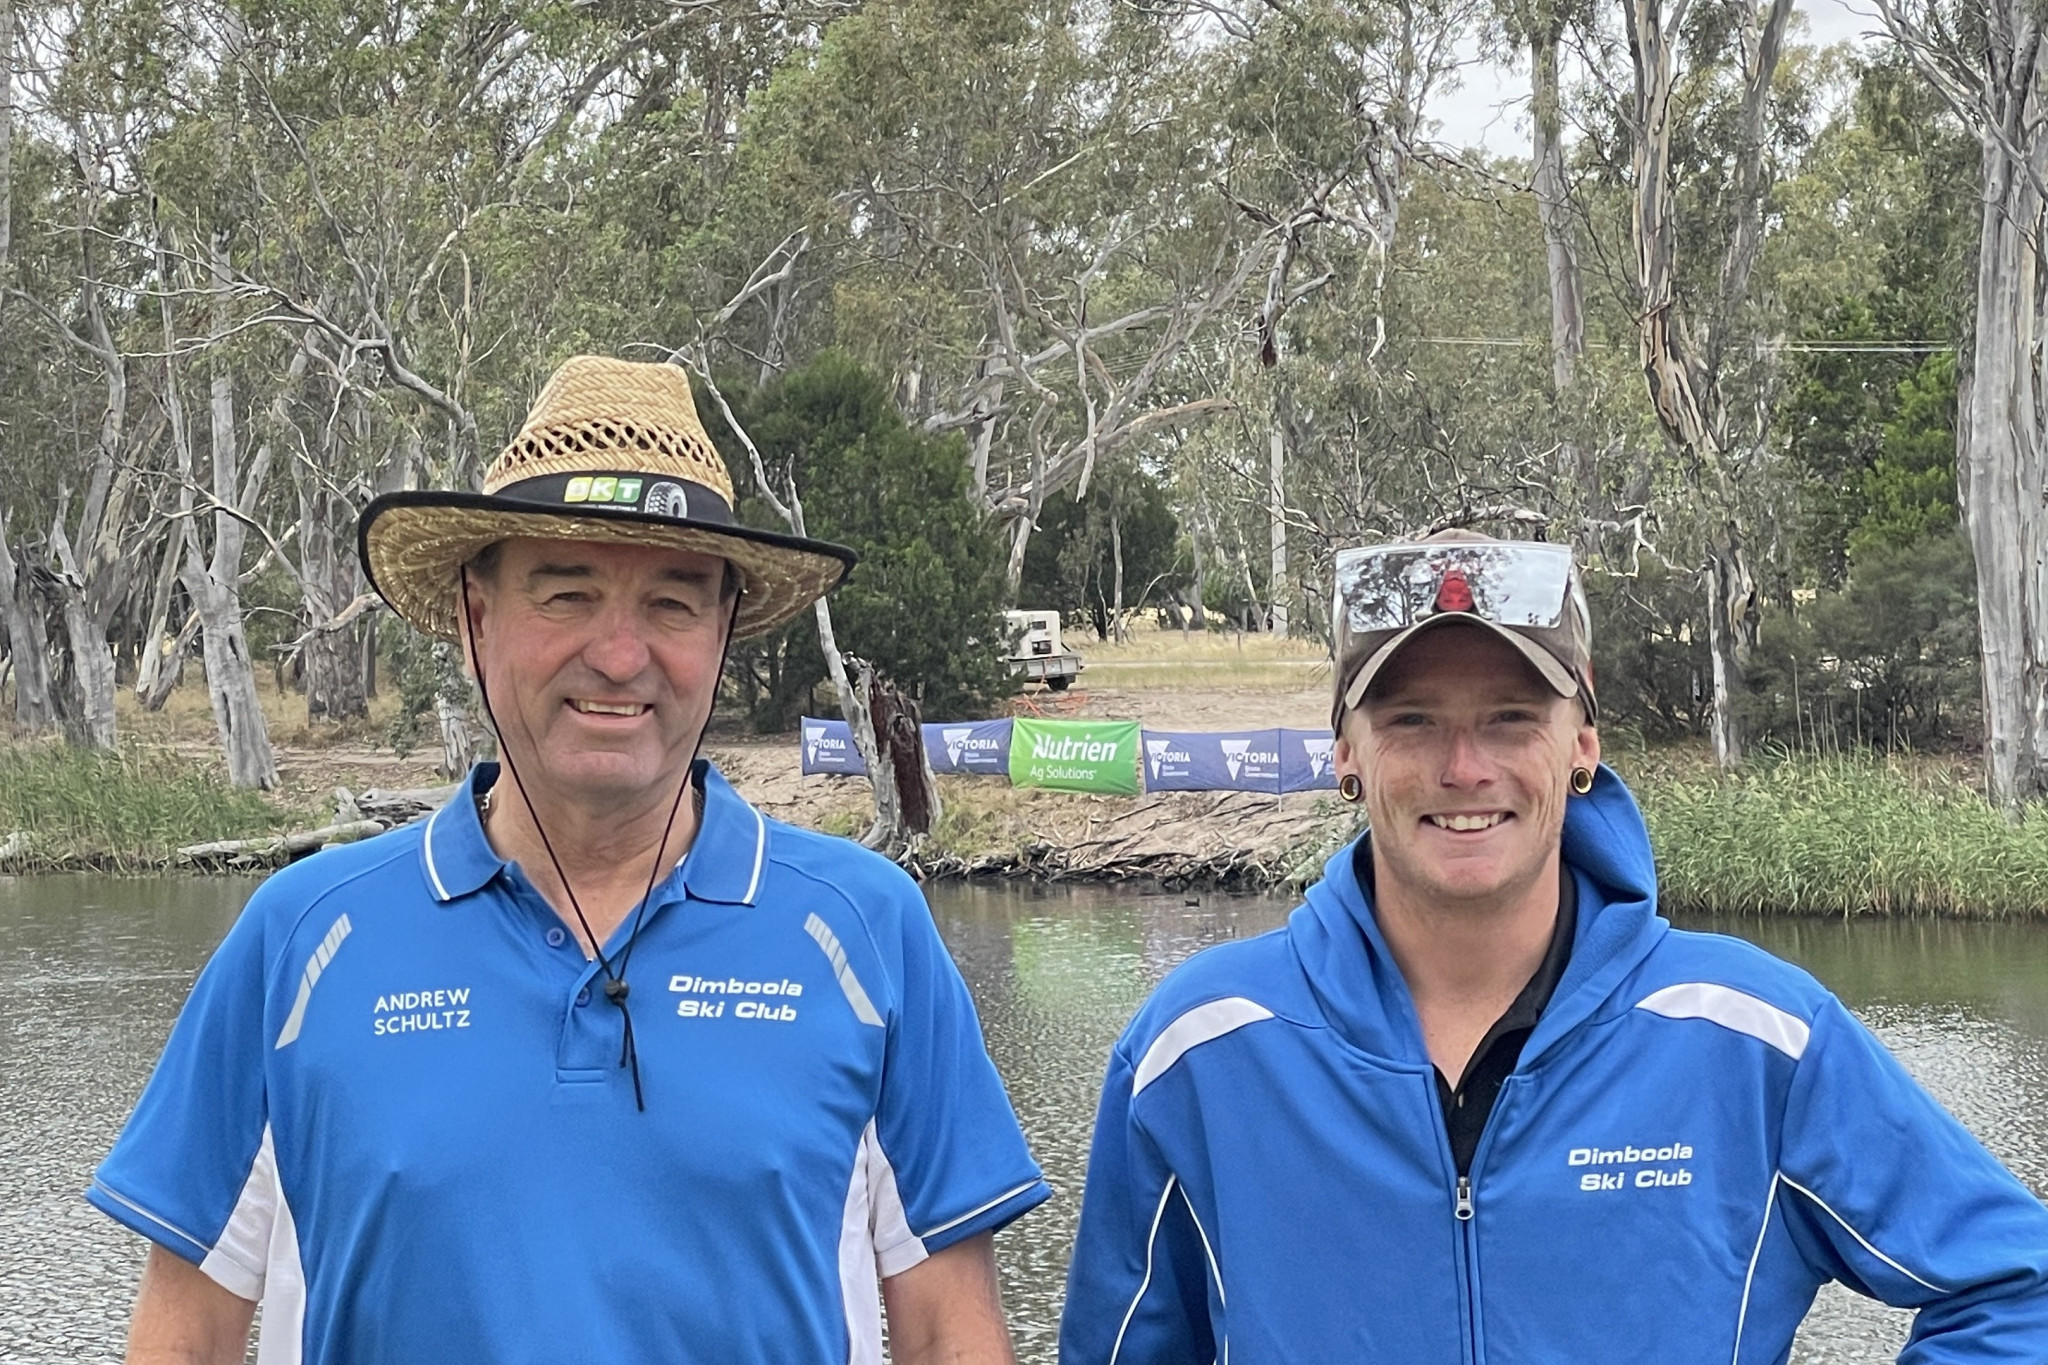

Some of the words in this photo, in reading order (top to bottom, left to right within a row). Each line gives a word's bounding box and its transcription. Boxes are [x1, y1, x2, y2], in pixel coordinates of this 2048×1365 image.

[946, 739, 999, 750] VICTORIA
[1031, 733, 1118, 762] Nutrien
[1149, 751, 1191, 763] VICTORIA
[1224, 751, 1279, 763] VICTORIA
[1029, 765, 1044, 782] Ag
[1046, 765, 1096, 780] Solutions
[668, 975, 803, 997] Dimboola
[374, 988, 470, 1014] ANDREW
[677, 1000, 725, 1018] Ski
[735, 1002, 797, 1021] Club
[374, 1010, 471, 1036] SCHULTZ
[1568, 1142, 1693, 1166] Dimboola
[1580, 1172, 1625, 1191] Ski
[1635, 1168, 1693, 1188] Club
